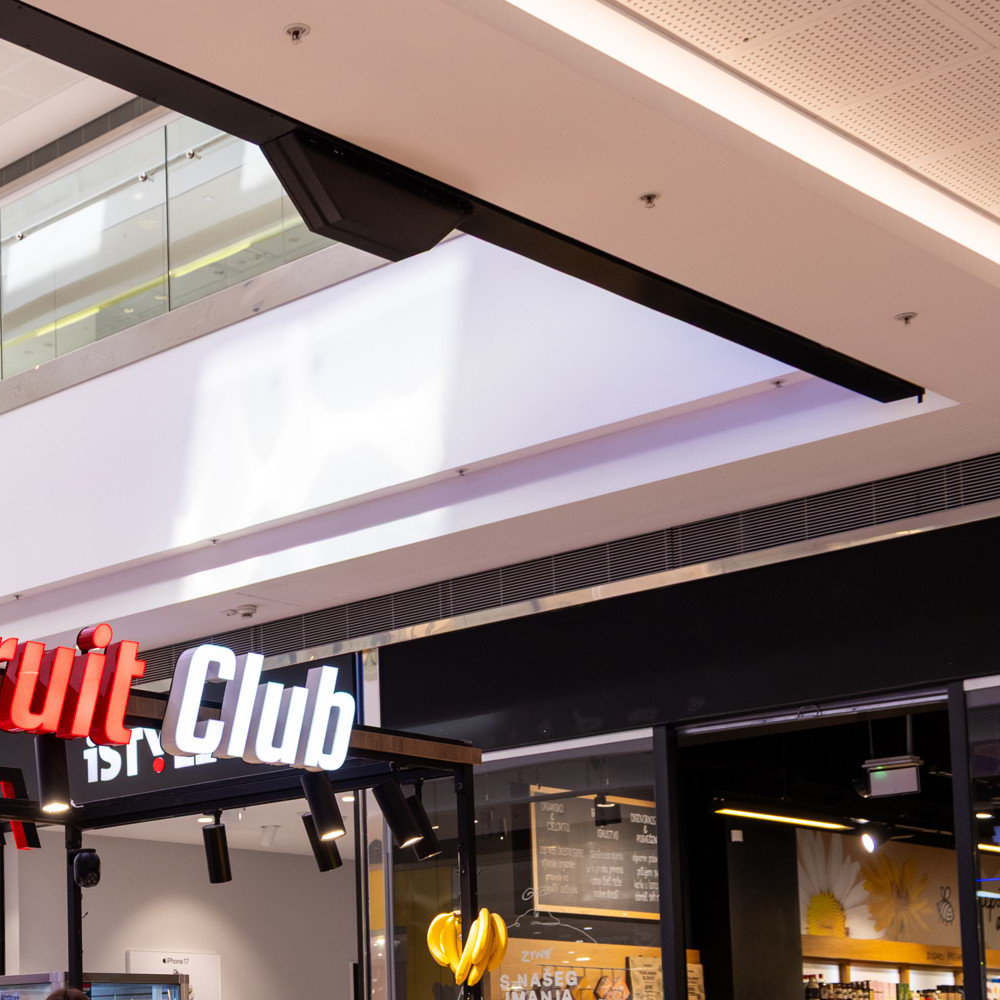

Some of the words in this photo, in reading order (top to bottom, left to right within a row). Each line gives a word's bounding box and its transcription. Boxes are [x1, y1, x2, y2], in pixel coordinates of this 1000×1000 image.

[161, 644, 355, 772] Club
[83, 726, 217, 783] iSTY
[500, 974, 510, 989] S
[517, 968, 578, 989] NAŠEG
